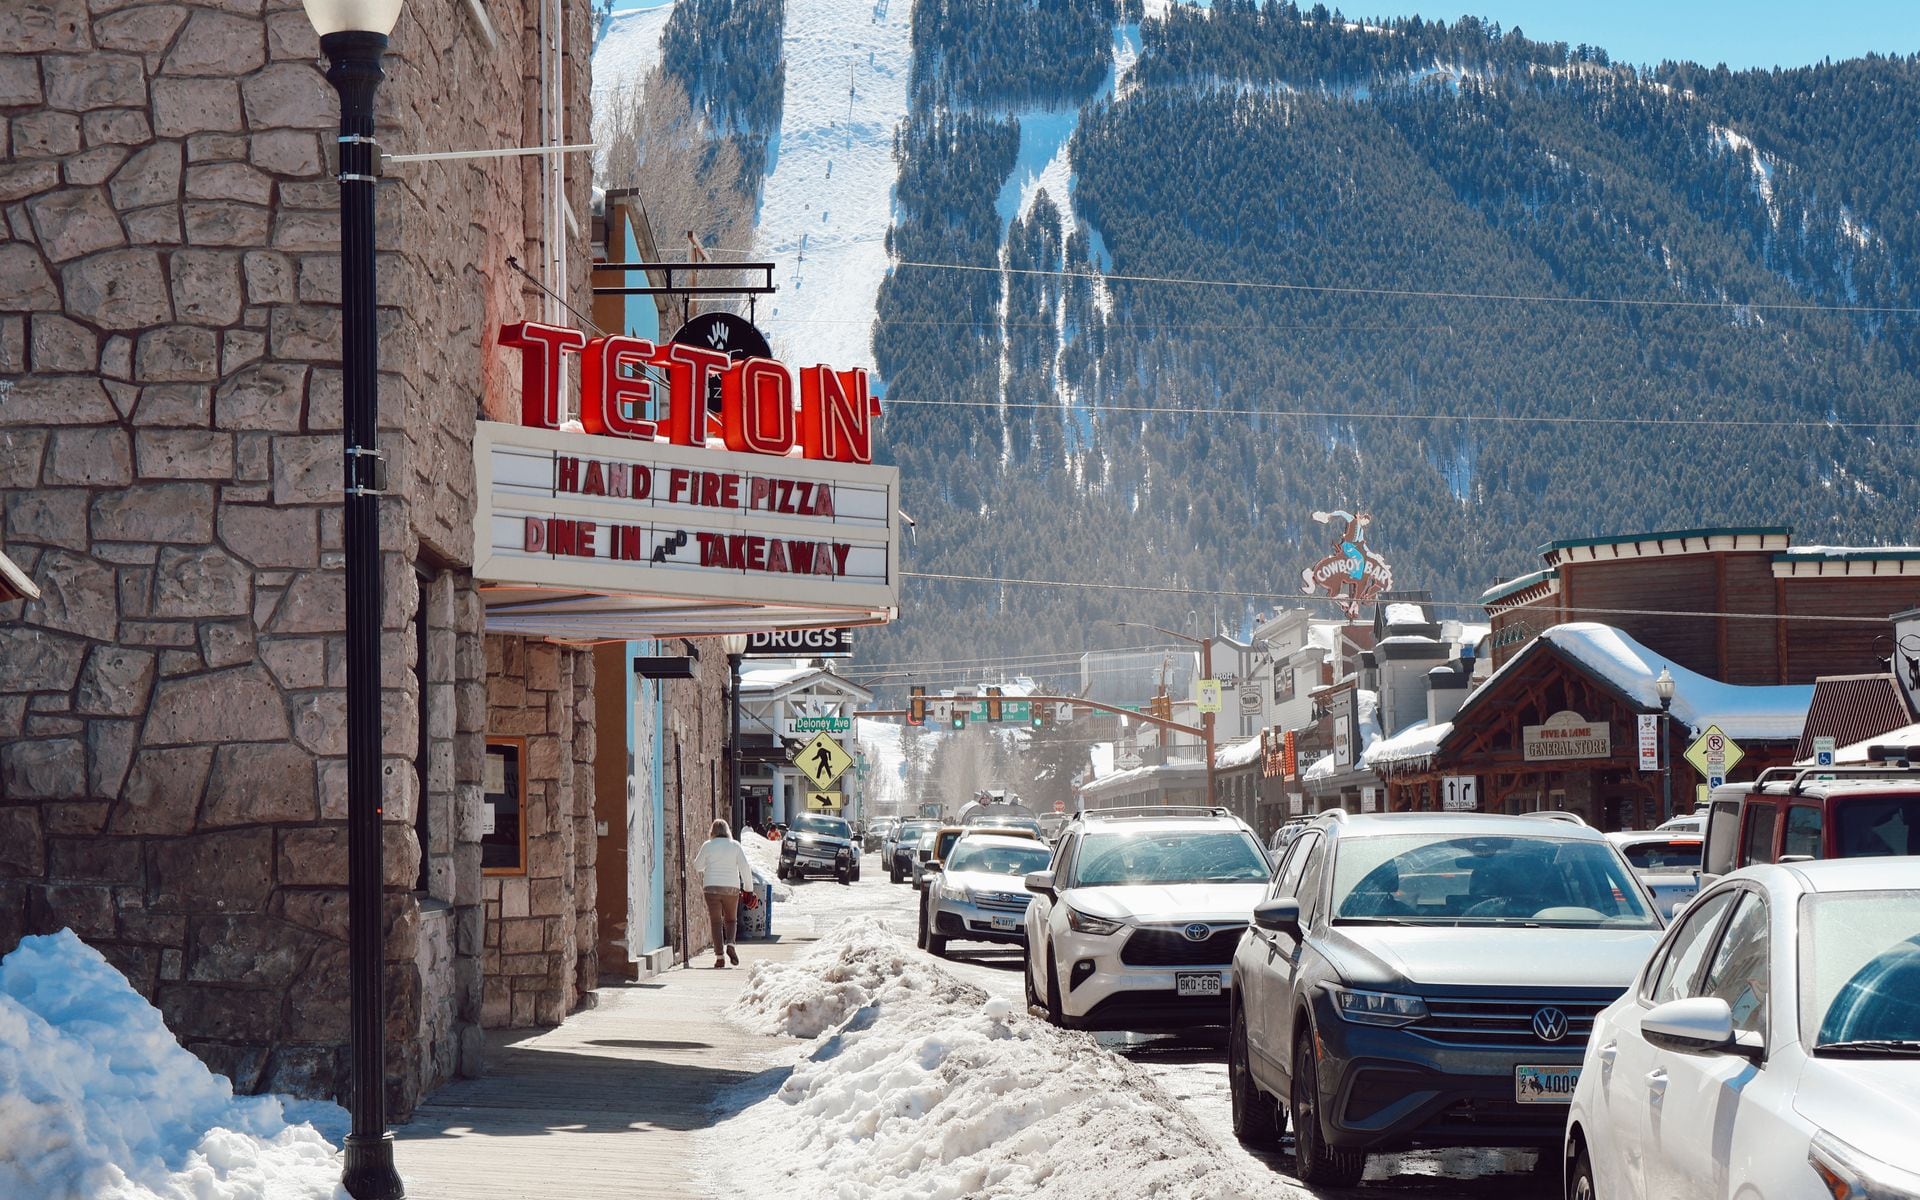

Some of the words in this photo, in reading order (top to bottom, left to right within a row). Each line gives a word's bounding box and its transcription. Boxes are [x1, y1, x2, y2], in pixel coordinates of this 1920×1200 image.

[521, 320, 873, 464] TETON
[559, 456, 651, 500] HAND
[669, 468, 740, 508] FIRE
[751, 476, 834, 516] PIZZA
[524, 516, 597, 557] DINE
[611, 525, 641, 561] IN
[652, 529, 687, 563] AND
[696, 532, 851, 577] TAKEAWAY
[1316, 558, 1361, 582] COWBOY
[1364, 561, 1389, 585] BAR
[752, 627, 837, 648] DRUGS
[797, 718, 831, 730] Deloney
[834, 718, 849, 728] Ave
[1540, 729, 1560, 739] FIVE
[1560, 728, 1568, 738] &
[1528, 740, 1573, 757] GENERAL
[1574, 738, 1607, 756] STORE
